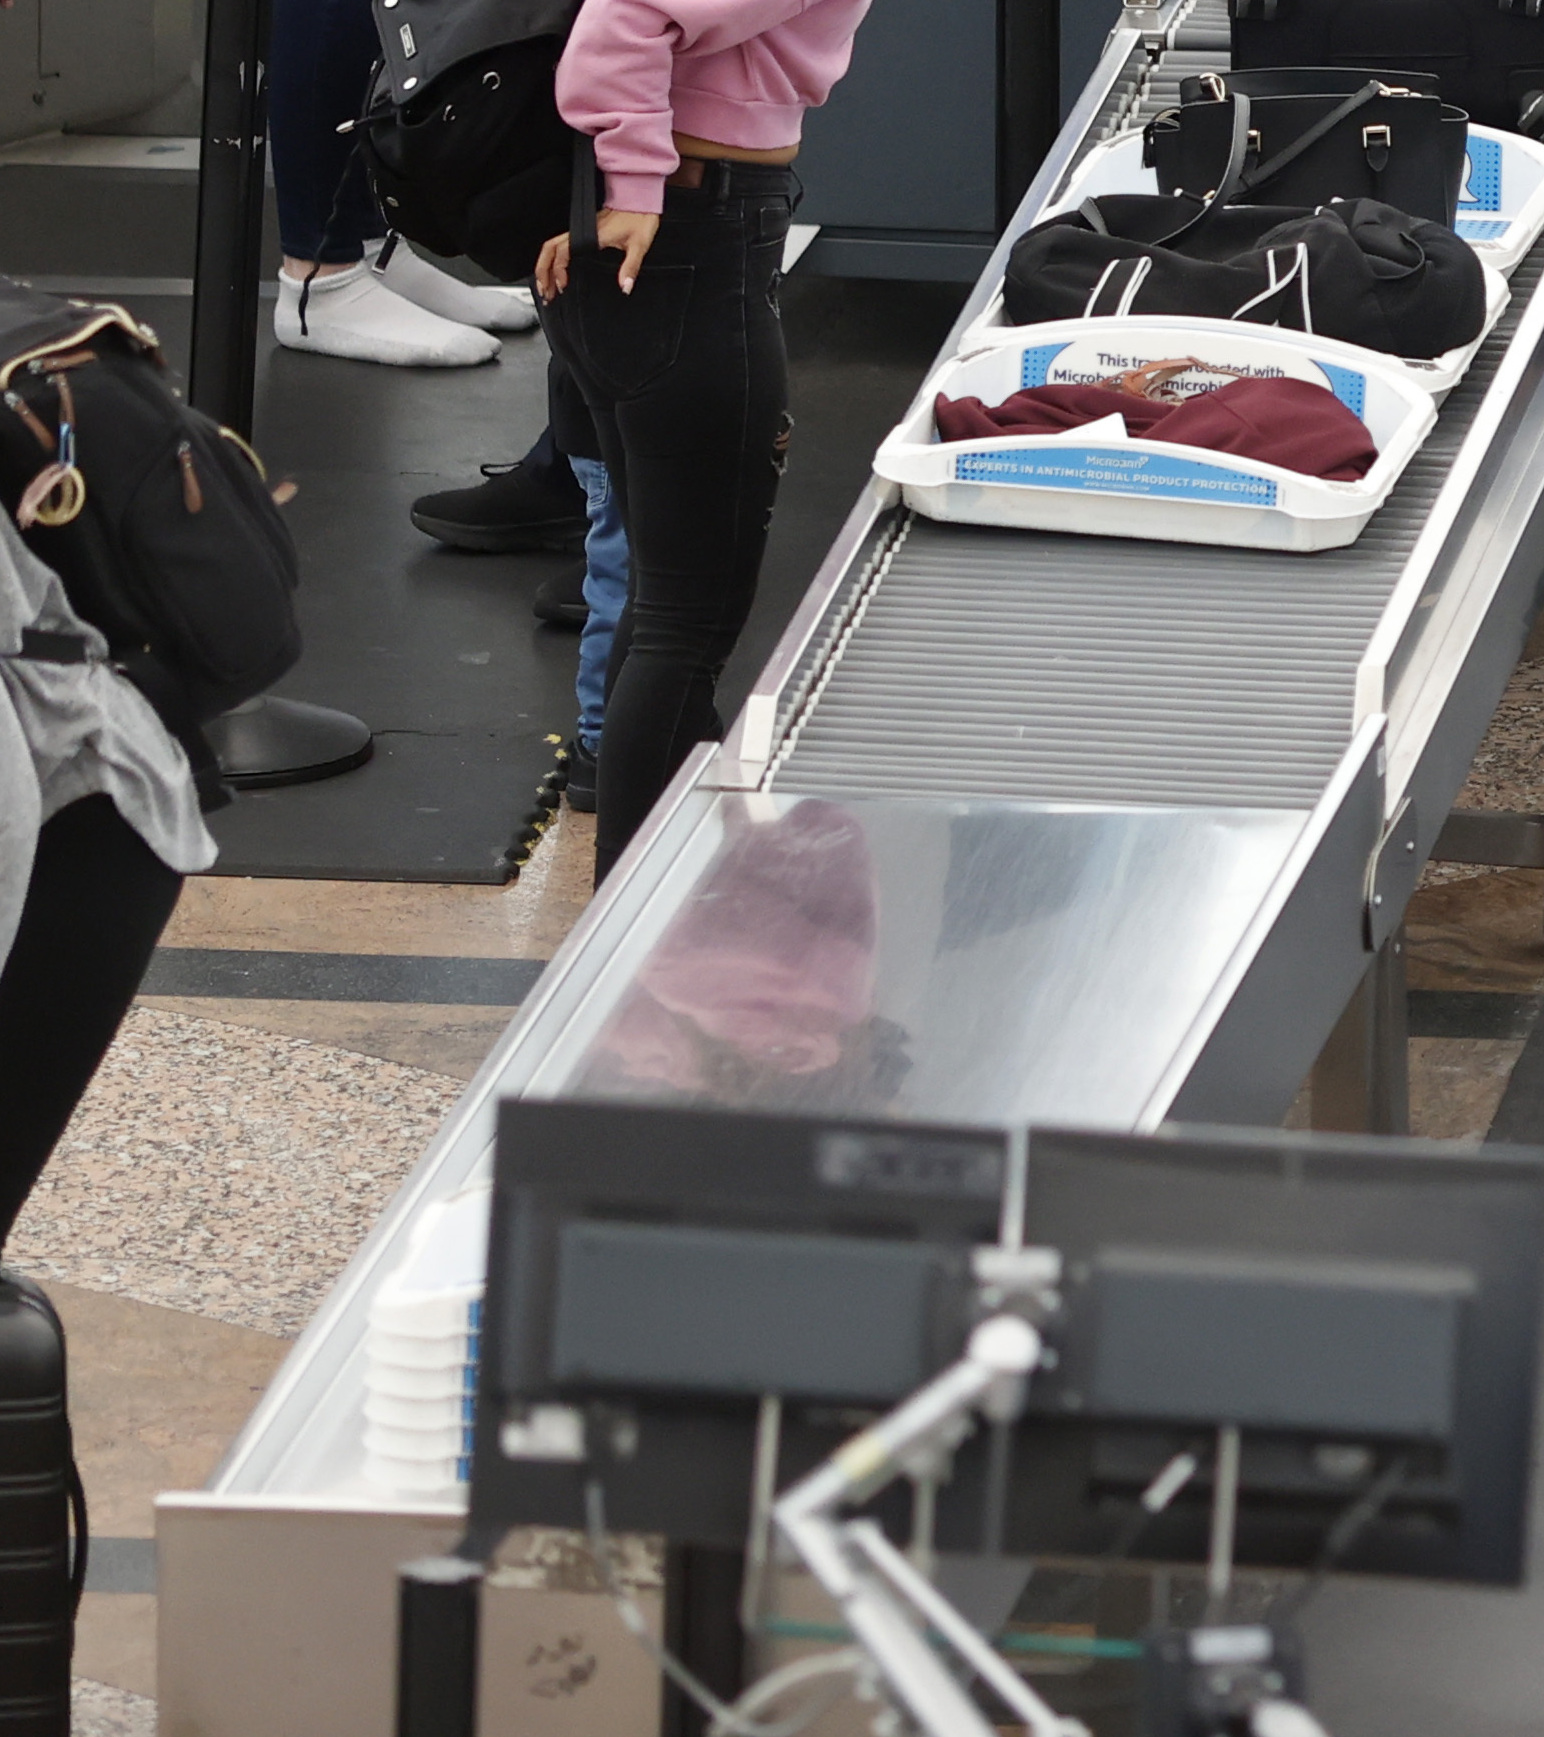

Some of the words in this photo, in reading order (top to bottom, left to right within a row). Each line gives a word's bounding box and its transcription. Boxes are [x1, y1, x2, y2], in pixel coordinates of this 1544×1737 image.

[1097, 353, 1128, 367] This
[1251, 366, 1285, 379] with
[964, 460, 1018, 473] EXPERTS
[1021, 464, 1034, 474] IN
[1036, 465, 1130, 482] ANTIMICROBIAL
[1133, 473, 1190, 488] PRODUCT
[1192, 478, 1269, 494] PROTECTION
